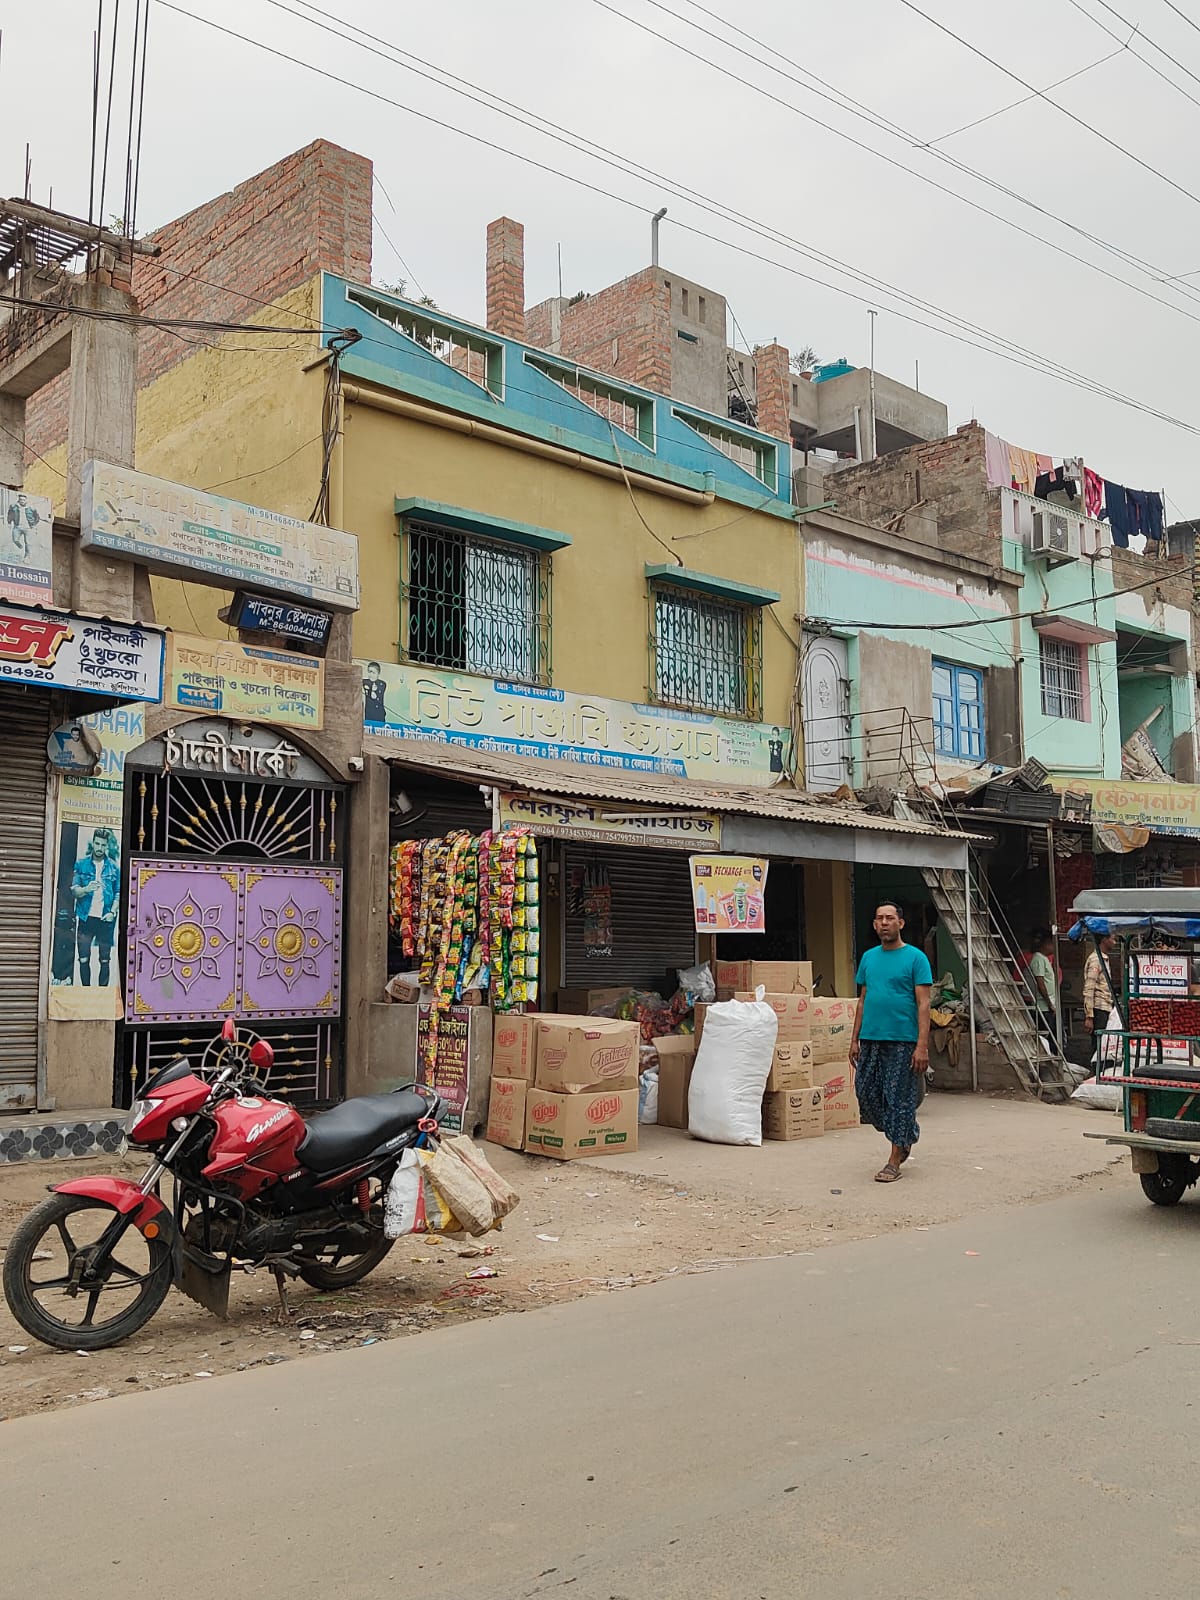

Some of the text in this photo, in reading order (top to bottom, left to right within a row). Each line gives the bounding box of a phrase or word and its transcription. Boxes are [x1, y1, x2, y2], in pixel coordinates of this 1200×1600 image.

[7, 567, 49, 584] Hossain
[247, 599, 284, 621] শাবনুর
[82, 625, 148, 649] পাইকারী
[80, 638, 141, 666] ও খুচরো
[182, 671, 310, 703] পাইকারী ও খুচরো বিক্রেতা
[406, 675, 486, 728] নিউ
[86, 777, 93, 785] is
